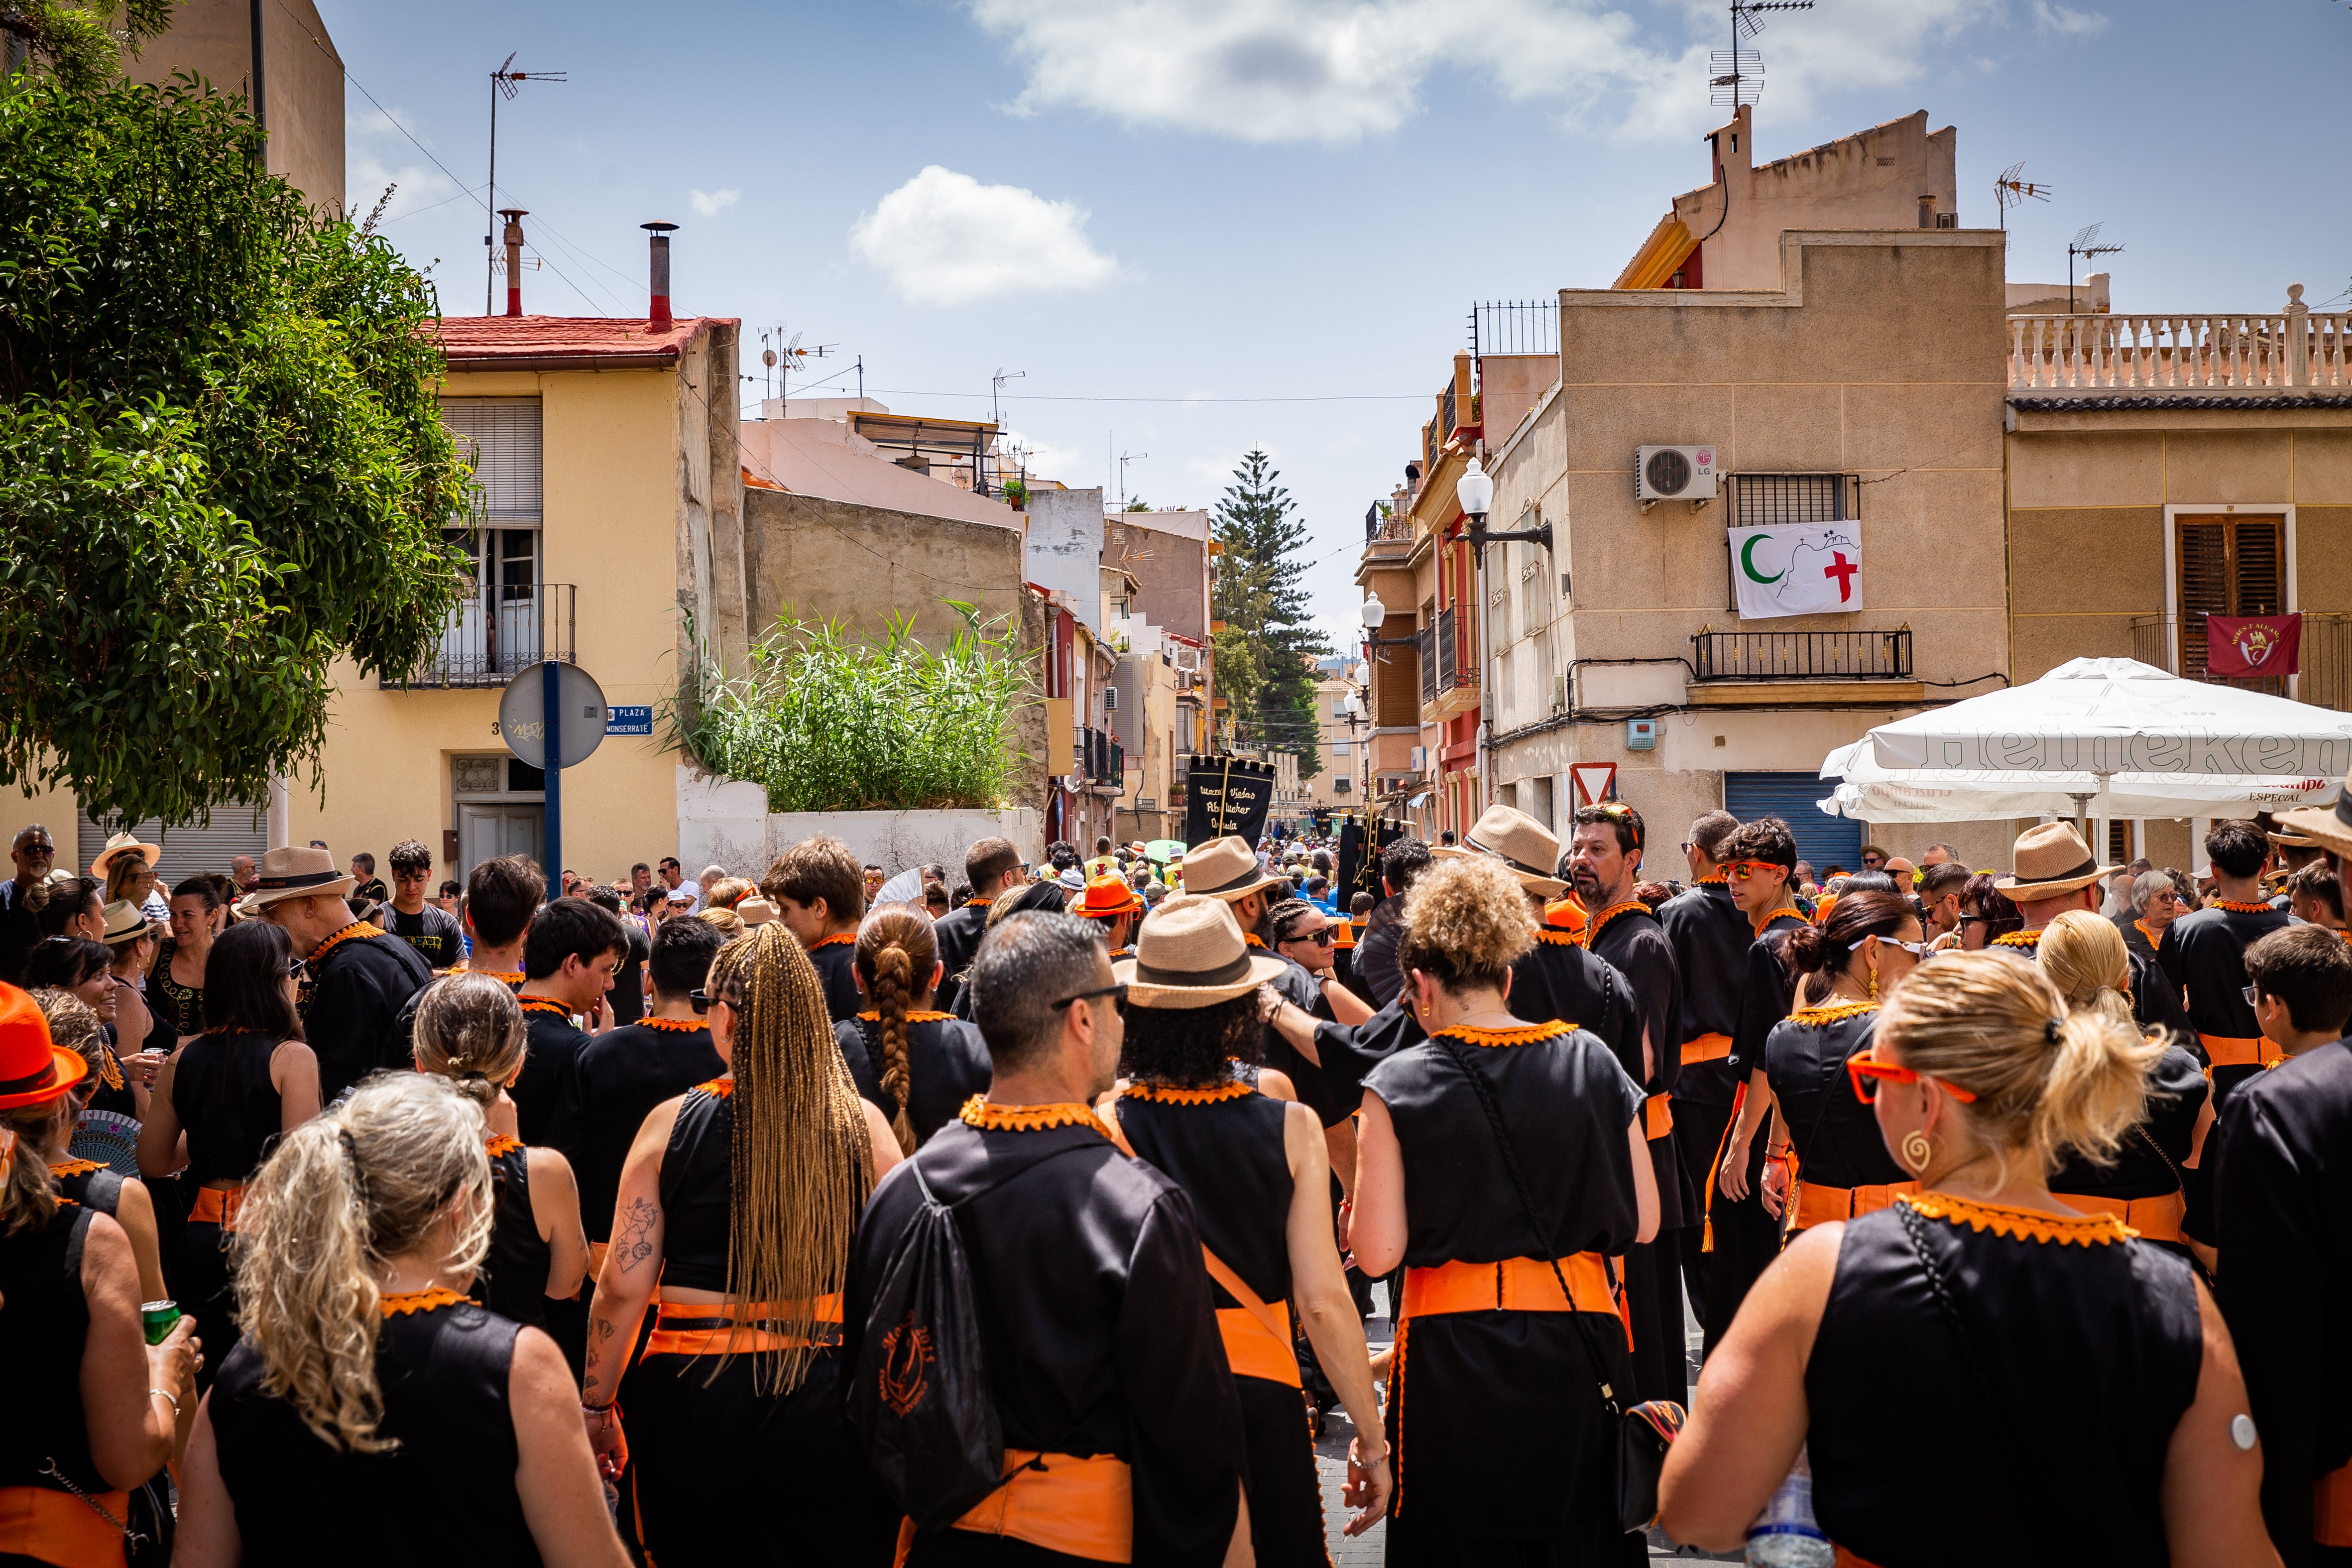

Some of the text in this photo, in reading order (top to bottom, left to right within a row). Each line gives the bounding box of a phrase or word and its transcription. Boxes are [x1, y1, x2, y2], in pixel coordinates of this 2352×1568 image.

[491, 722, 500, 735] 3
[1916, 724, 2351, 775] Heineken
[1200, 786, 1256, 800] Moro Viejos
[2249, 792, 2302, 803] ESPECIAL
